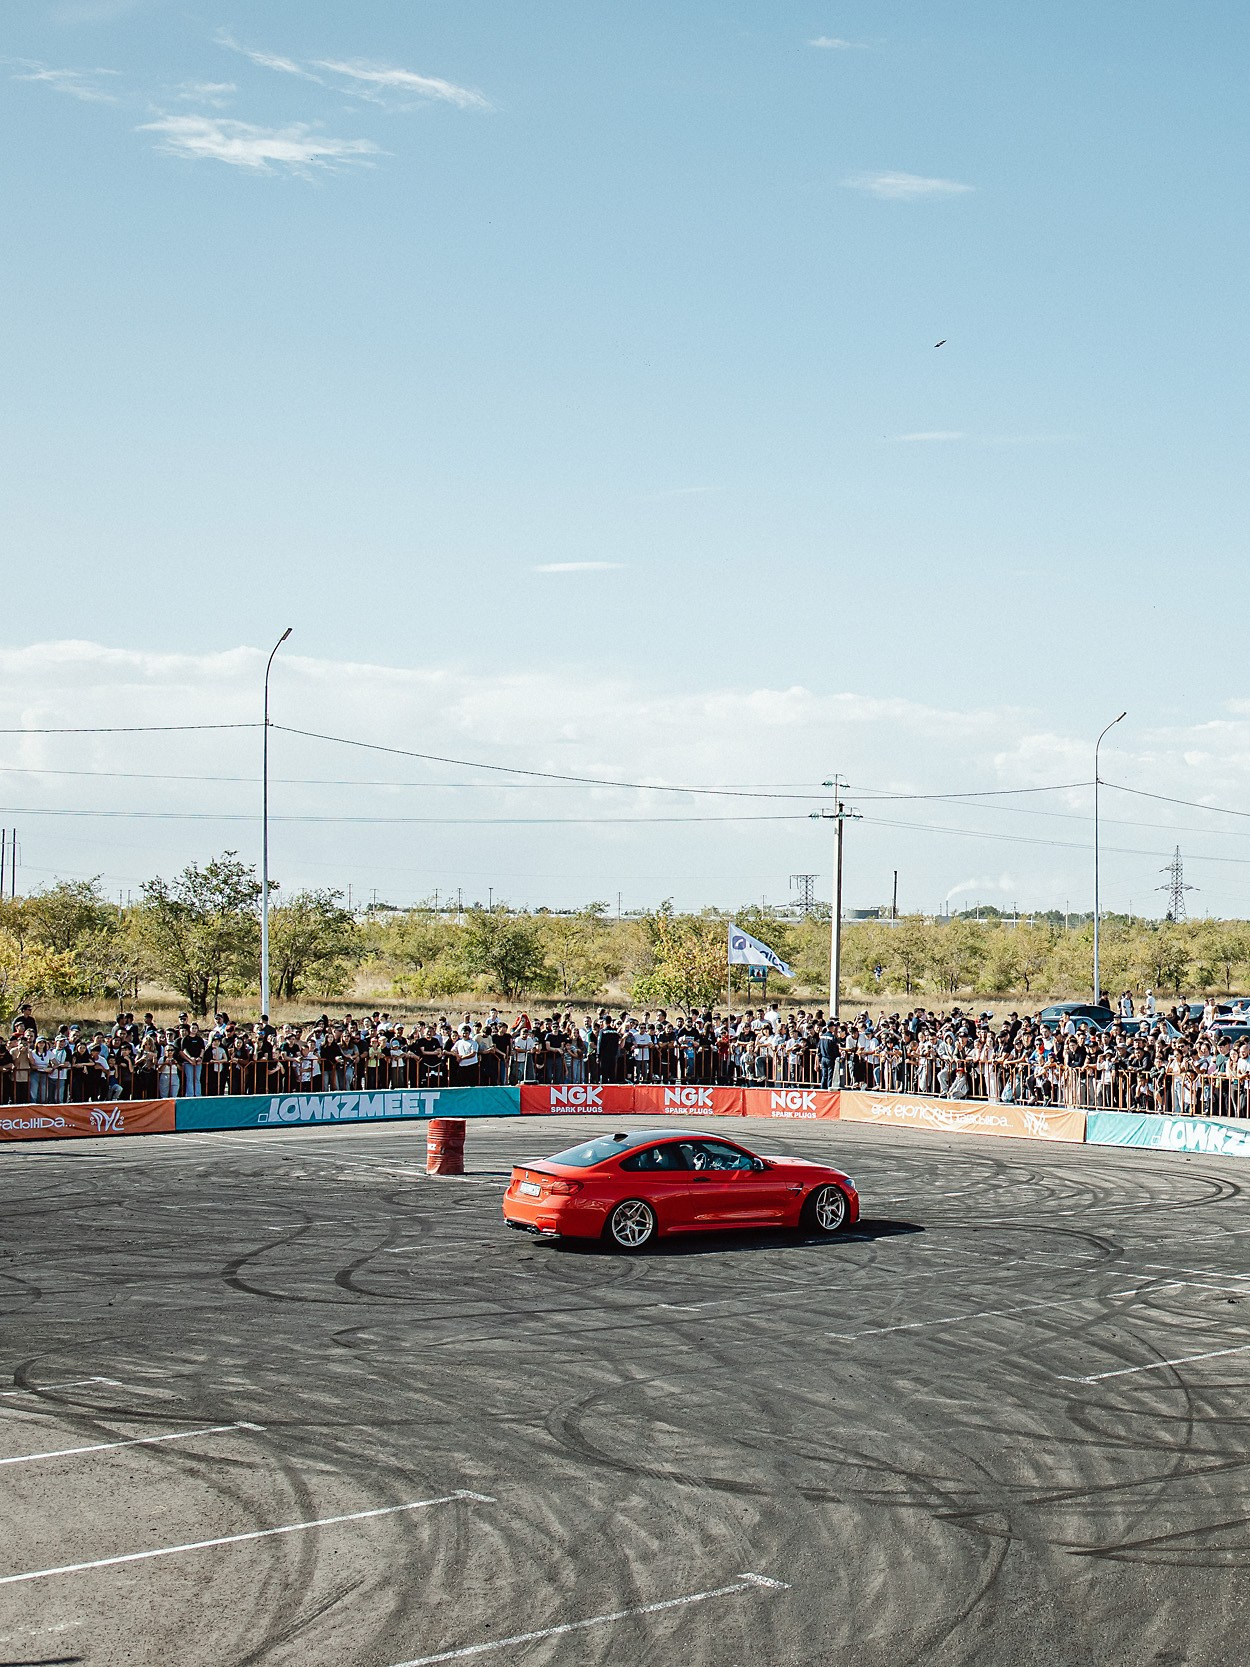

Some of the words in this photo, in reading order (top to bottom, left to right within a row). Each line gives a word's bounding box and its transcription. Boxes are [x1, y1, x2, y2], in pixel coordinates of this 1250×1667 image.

[550, 1086, 603, 1105] NGK
[664, 1087, 714, 1107] NGK
[771, 1090, 817, 1110] NGK
[268, 1092, 441, 1122] LOWKZMEET
